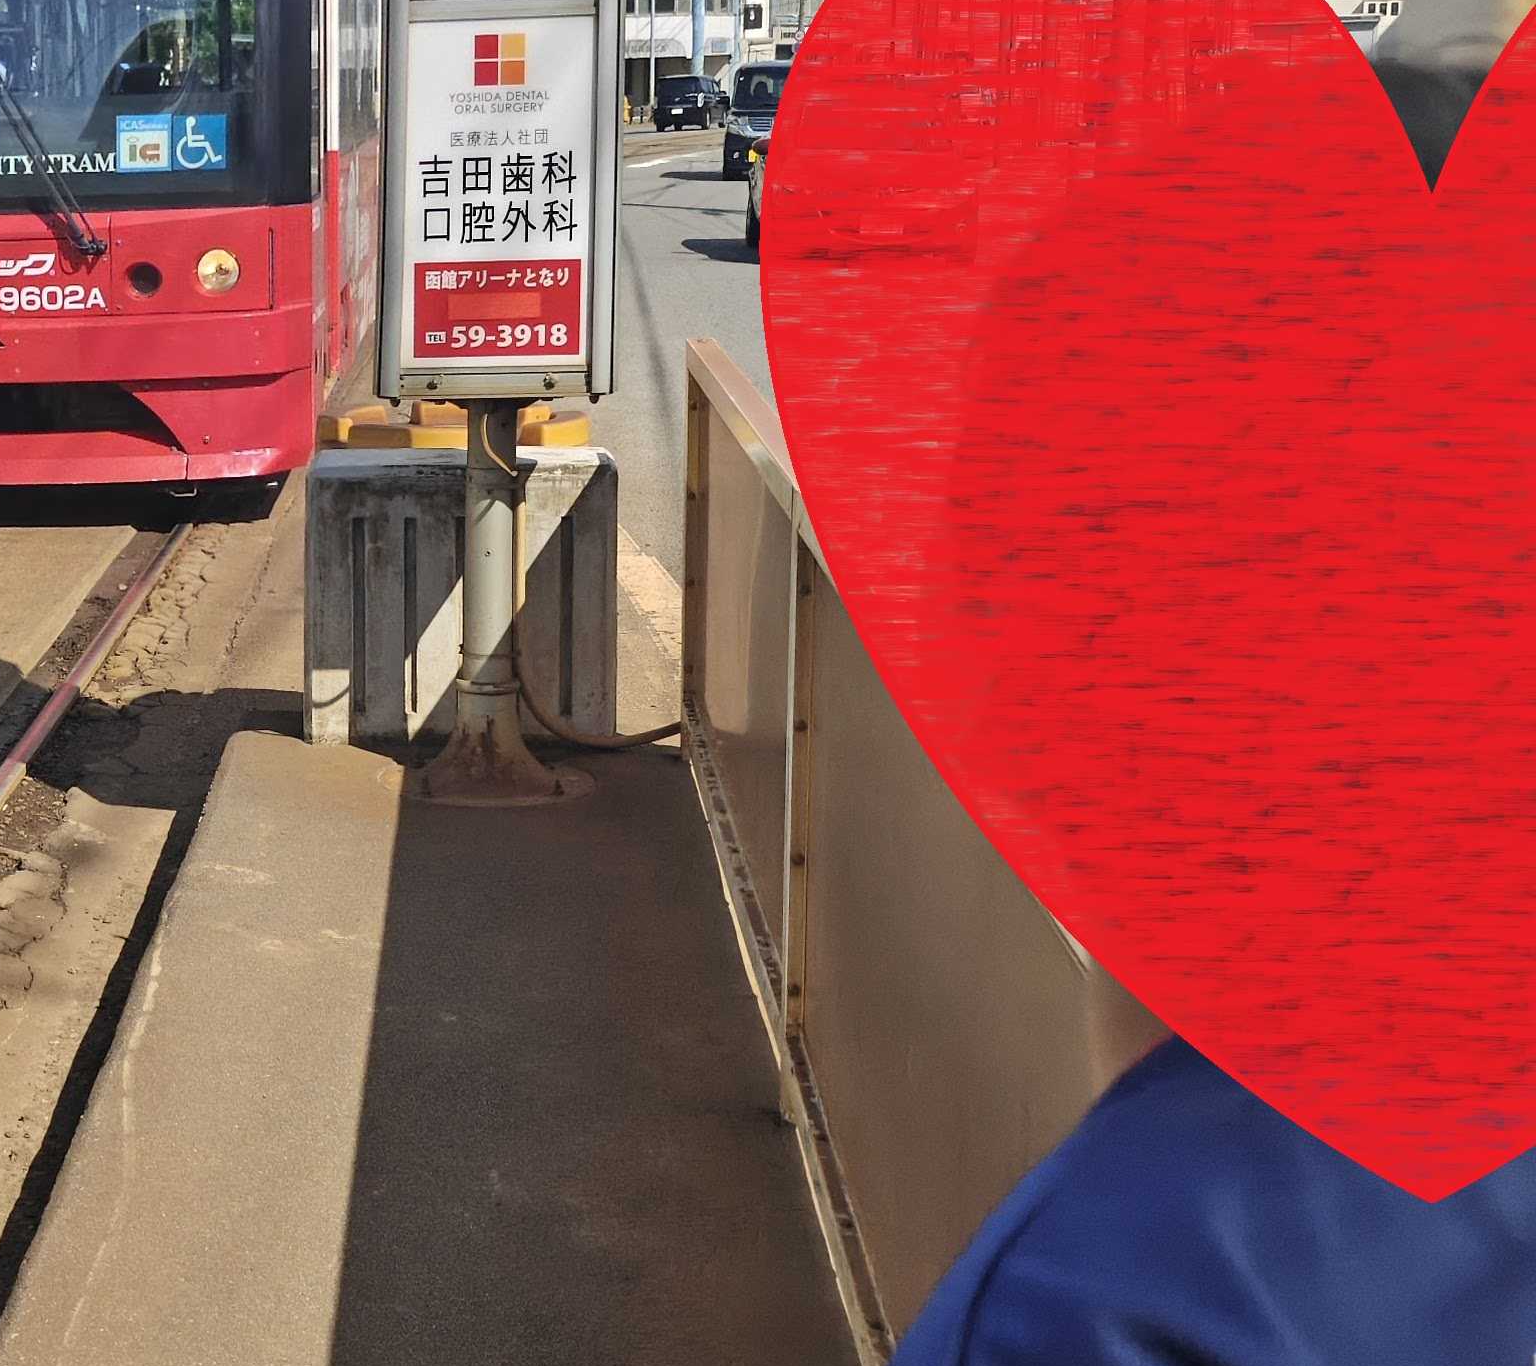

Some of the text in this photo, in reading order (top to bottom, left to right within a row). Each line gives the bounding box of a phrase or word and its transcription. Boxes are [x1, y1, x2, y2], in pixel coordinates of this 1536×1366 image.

[449, 90, 549, 103] YOSHIDA DENTAL
[454, 102, 544, 115] ORAL SURGERY
[450, 129, 548, 147] 医療法人社団
[41, 152, 116, 174] TRAM
[418, 150, 577, 197] 吉田歯科
[424, 198, 578, 243] 口腔外科
[425, 267, 569, 290] 函館アリーナとなり
[0, 285, 106, 311] 9602A
[427, 324, 568, 348] TEL 59-3918
